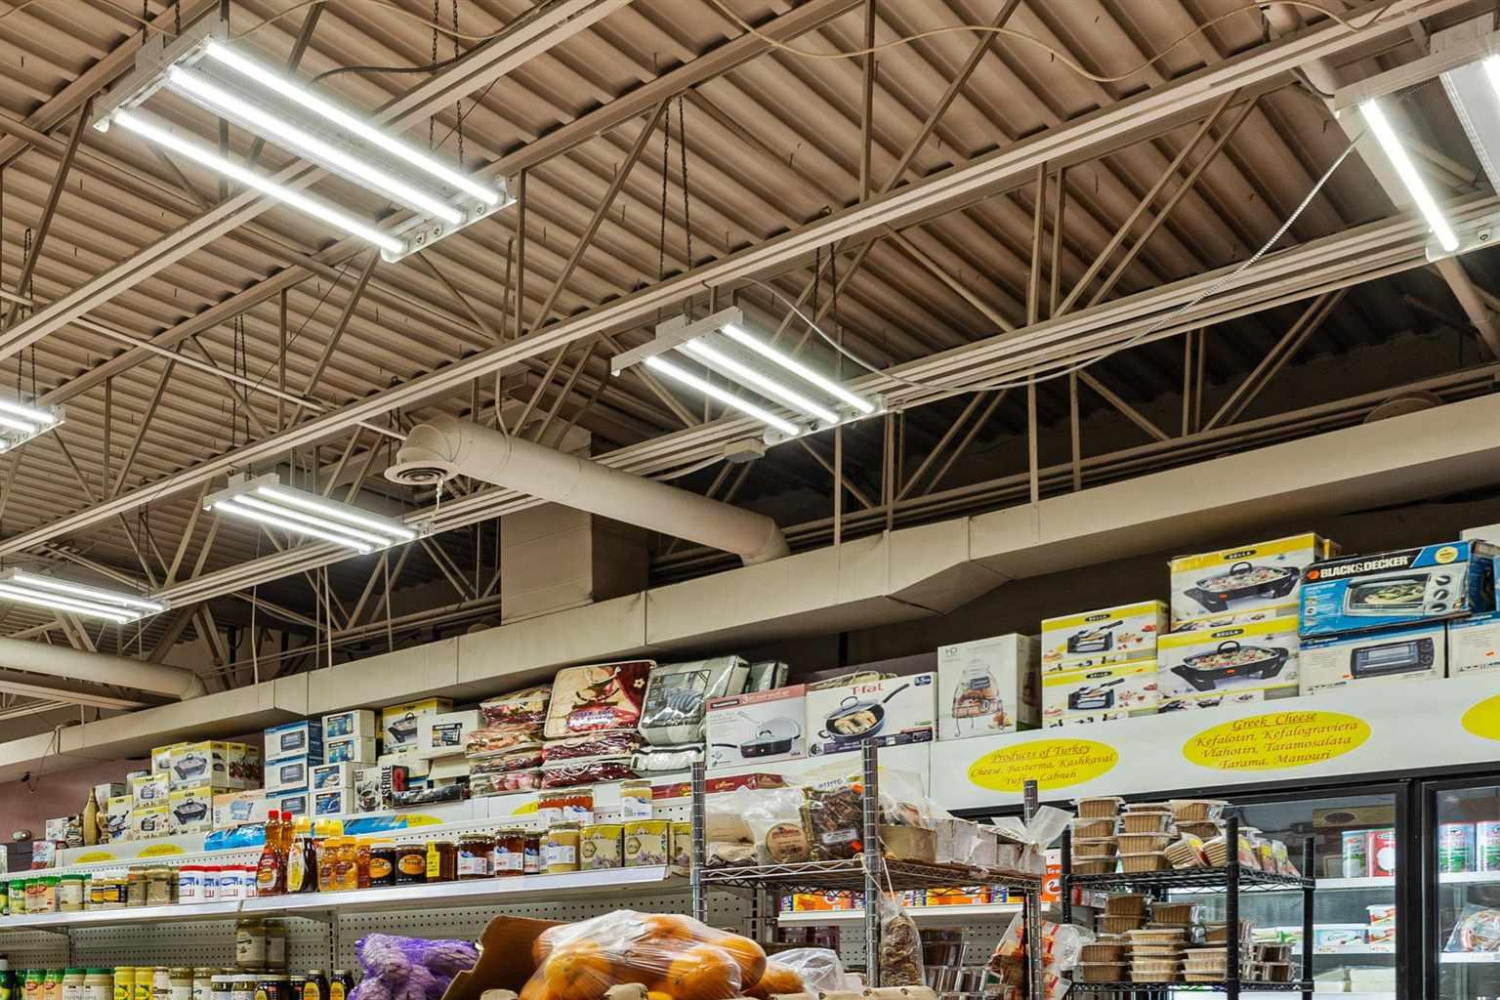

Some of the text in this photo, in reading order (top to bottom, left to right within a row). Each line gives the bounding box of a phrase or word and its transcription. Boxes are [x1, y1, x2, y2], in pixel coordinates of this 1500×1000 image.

[1320, 555, 1409, 579] BLACK&DECKER
[1232, 712, 1317, 731] Greek Cheese
[1051, 743, 1091, 757] Turkey
